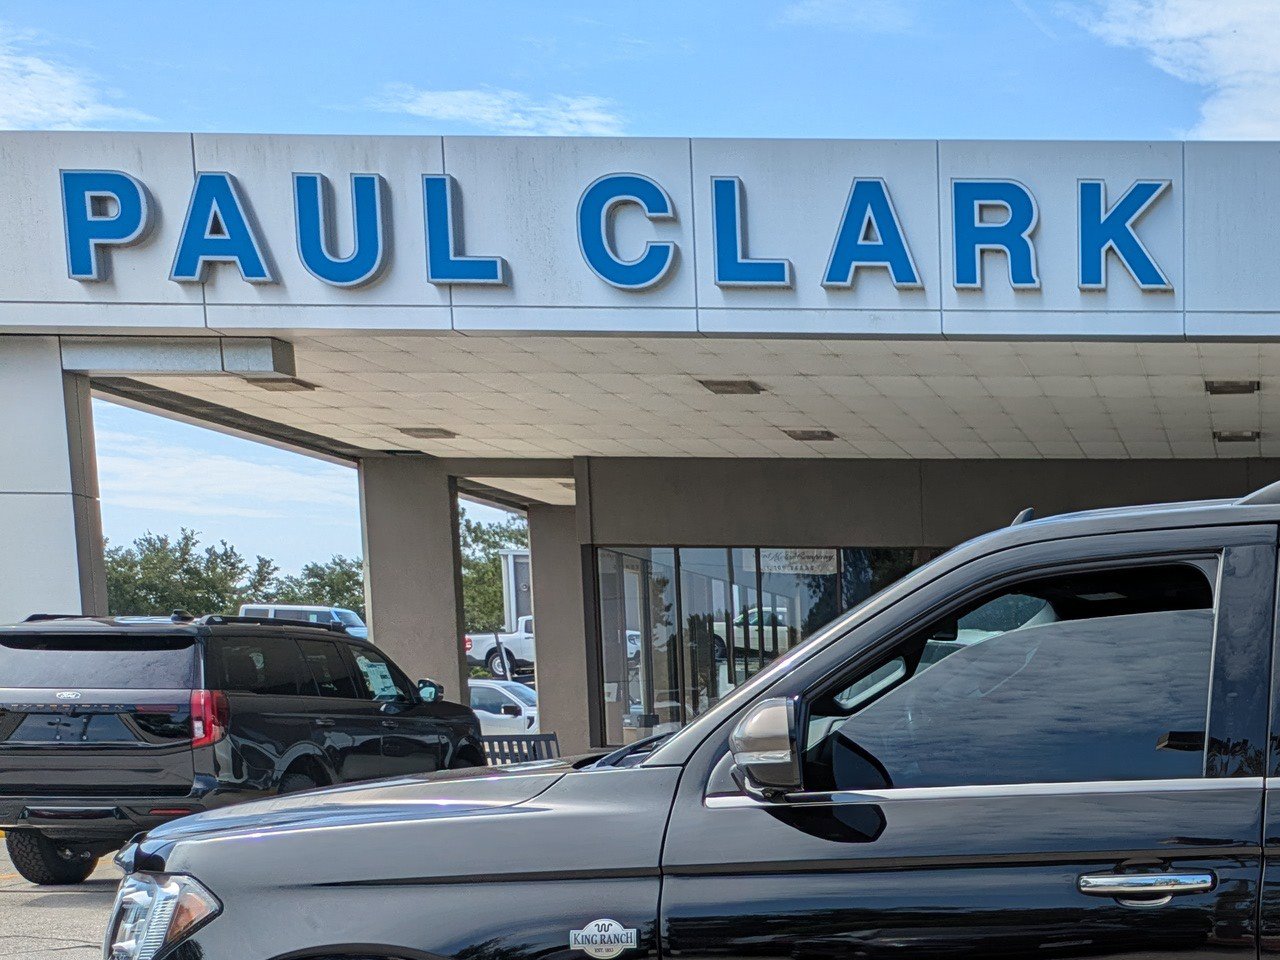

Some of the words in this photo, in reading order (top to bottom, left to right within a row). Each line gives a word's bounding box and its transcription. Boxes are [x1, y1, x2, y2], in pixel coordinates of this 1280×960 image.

[59, 168, 507, 288] PAUL
[576, 172, 1174, 291] CLARK
[573, 933, 598, 945] KING
[600, 932, 633, 945] RANCH
